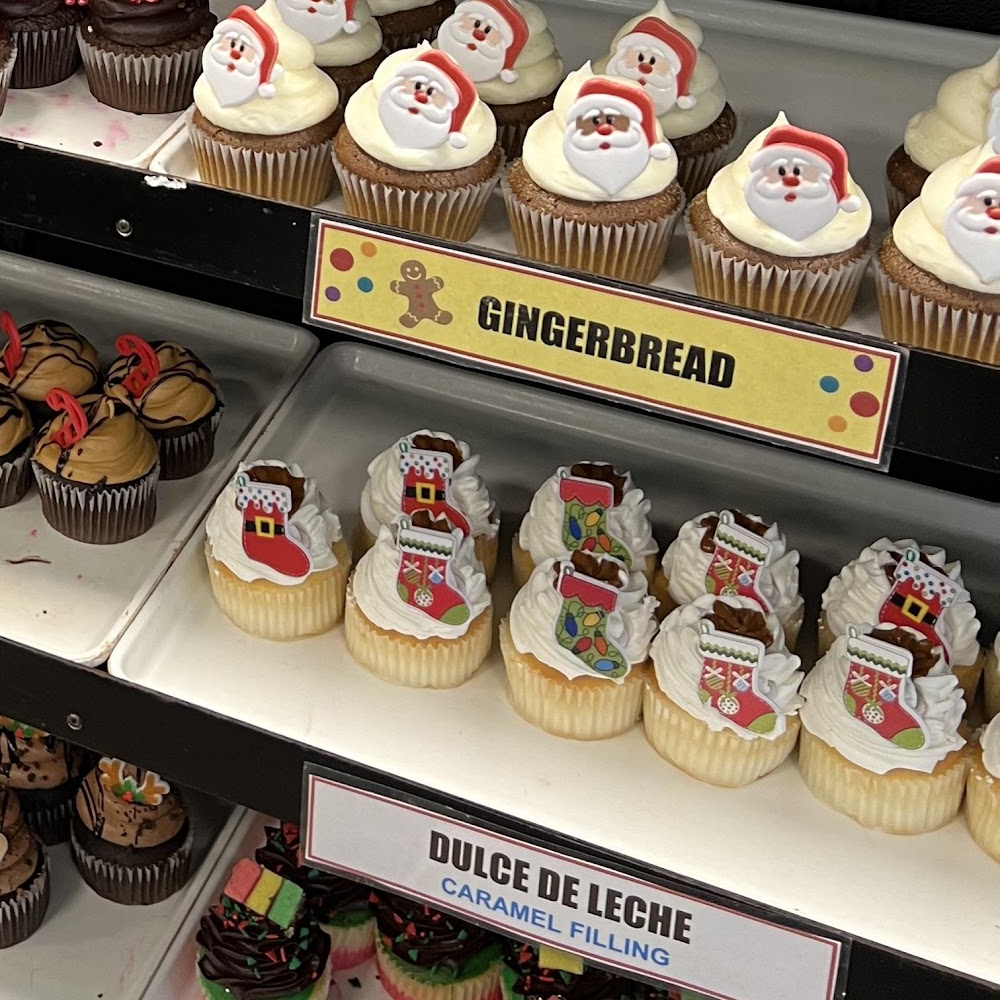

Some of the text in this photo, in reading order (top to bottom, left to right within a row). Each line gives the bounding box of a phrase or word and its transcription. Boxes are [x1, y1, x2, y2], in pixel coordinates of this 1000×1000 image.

[477, 295, 735, 389] GINGERBREAD
[429, 830, 692, 944] DULCE DE LECHE
[441, 877, 671, 966] CARAMEL FILLING
